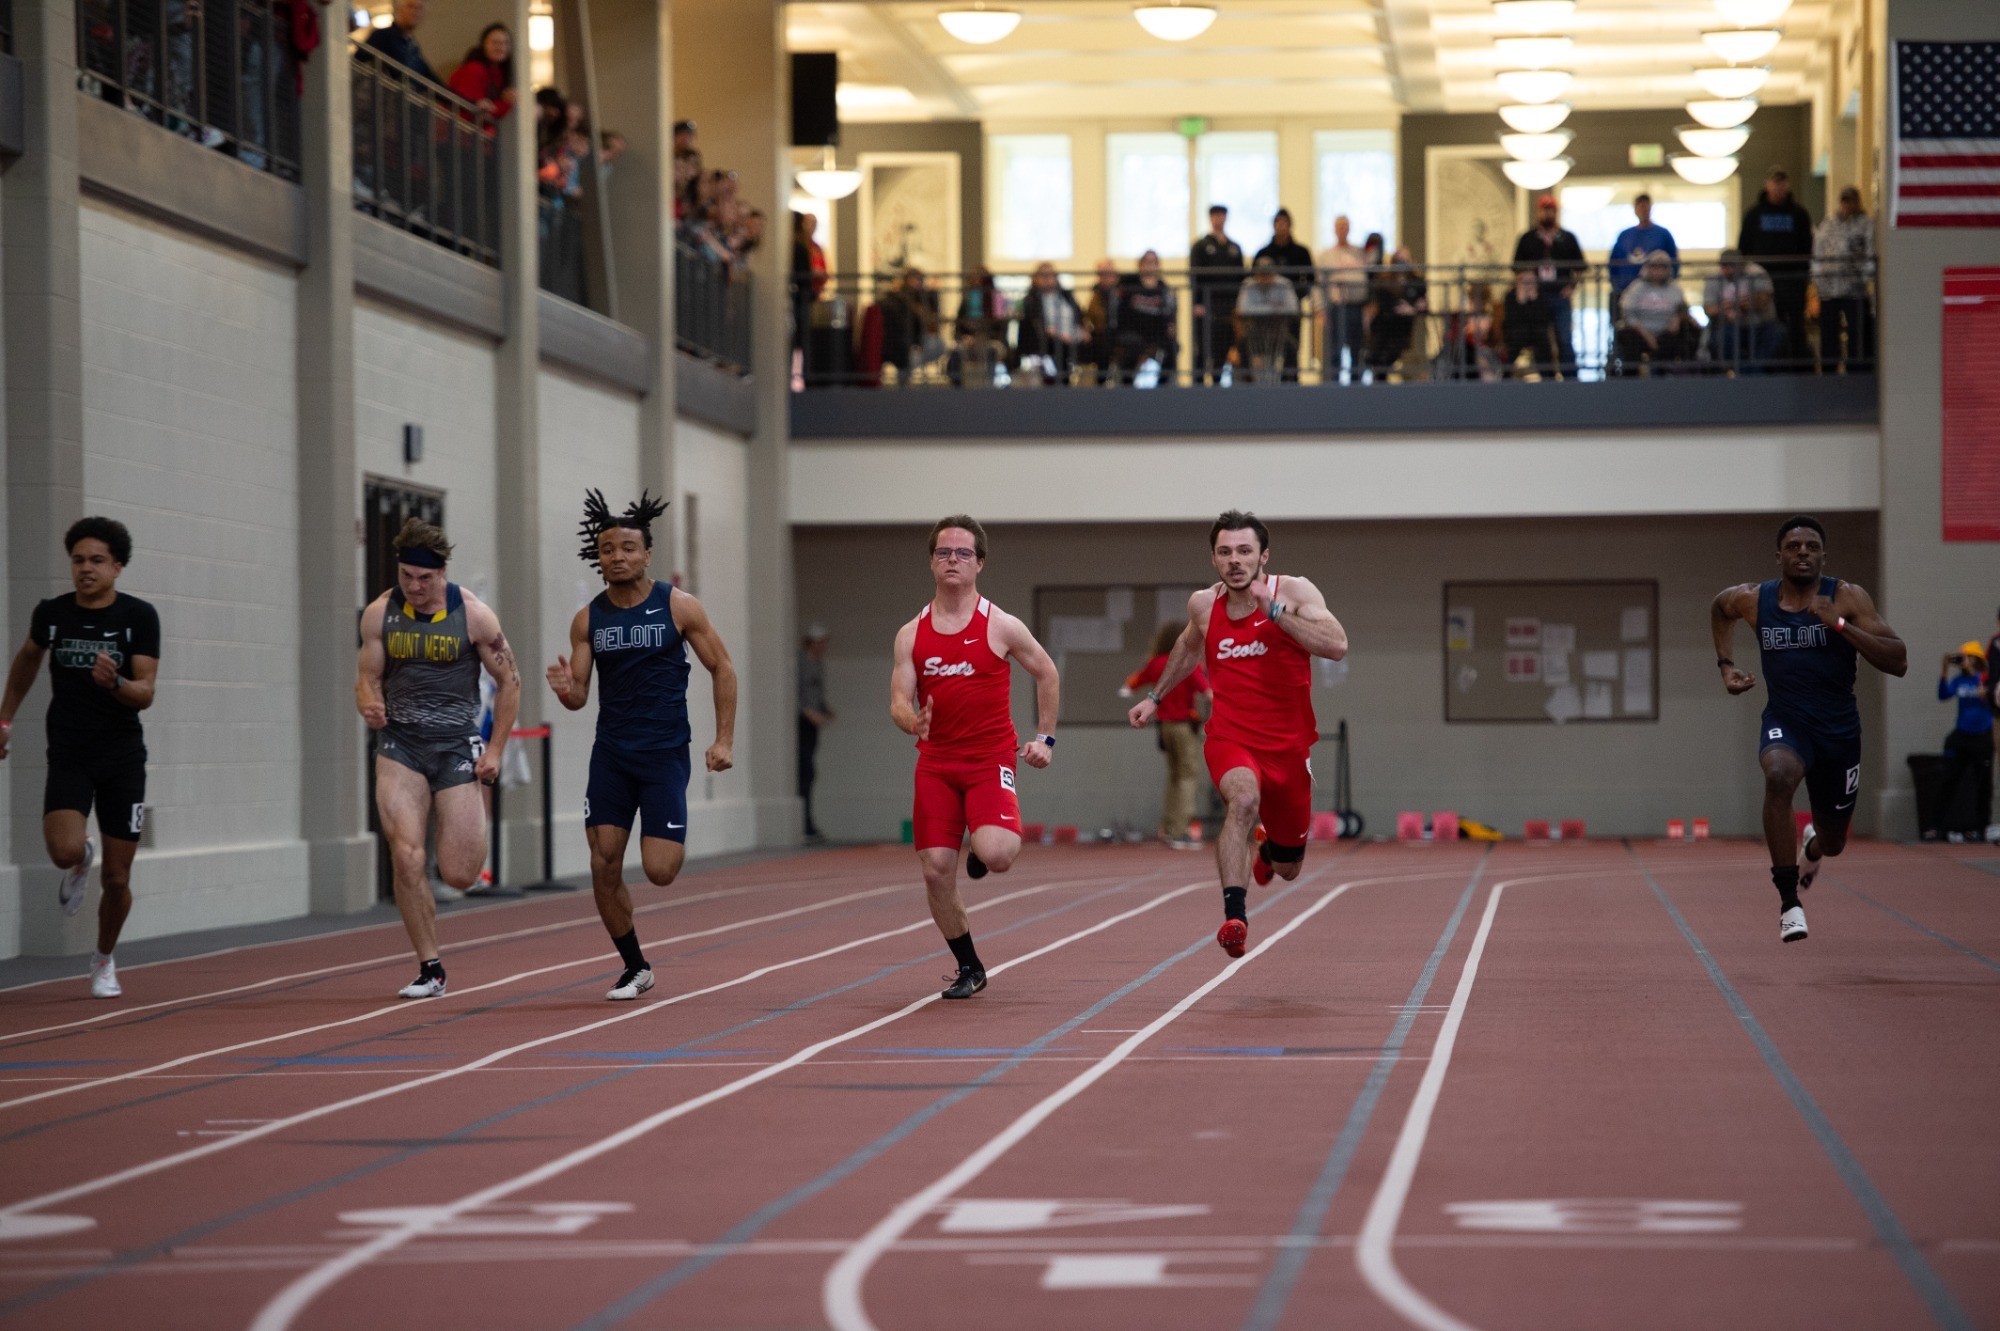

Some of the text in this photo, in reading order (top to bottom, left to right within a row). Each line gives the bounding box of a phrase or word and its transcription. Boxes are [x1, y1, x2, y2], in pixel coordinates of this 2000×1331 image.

[387, 632, 460, 662] MOUNT MERCY
[594, 624, 665, 652] BELOIT
[1216, 637, 1269, 659] Scots
[1761, 624, 1828, 650] BELOIT
[923, 656, 976, 676] Scots
[1768, 728, 1783, 739] B
[1003, 769, 1014, 788] 5
[1848, 768, 1859, 792] 2
